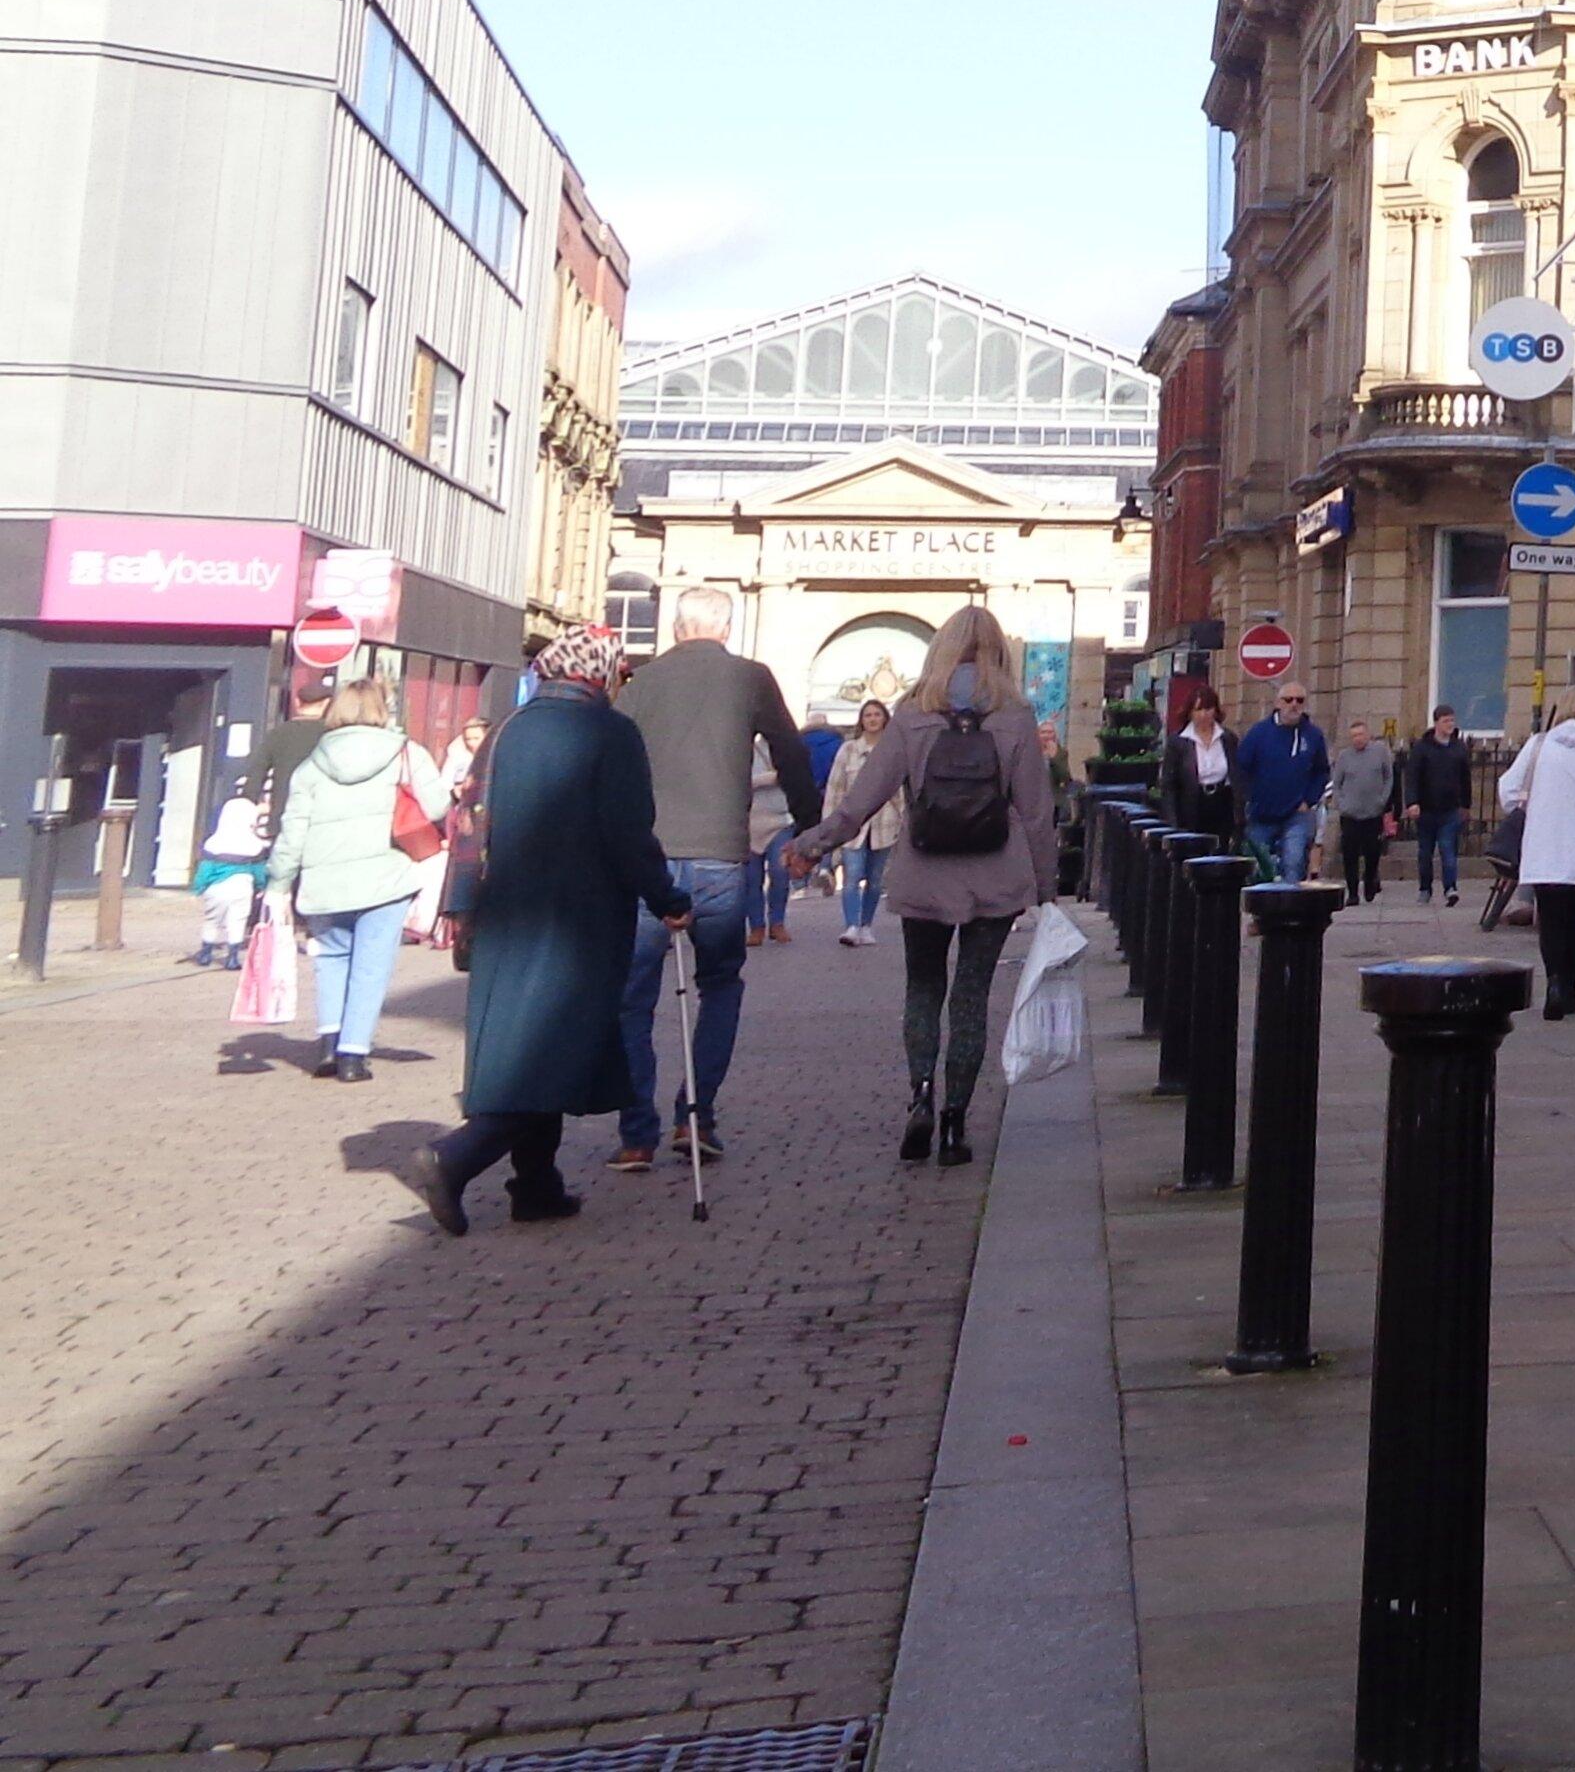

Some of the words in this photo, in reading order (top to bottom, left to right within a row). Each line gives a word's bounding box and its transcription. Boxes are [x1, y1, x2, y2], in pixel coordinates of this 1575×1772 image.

[1415, 33, 1537, 77] BANK
[1490, 338, 1557, 358] TSB
[783, 530, 898, 553] MARKET
[912, 530, 996, 553] PLACE
[1516, 550, 1547, 563] One
[784, 561, 900, 576] SHOPPING
[912, 561, 993, 576] CENTRE
